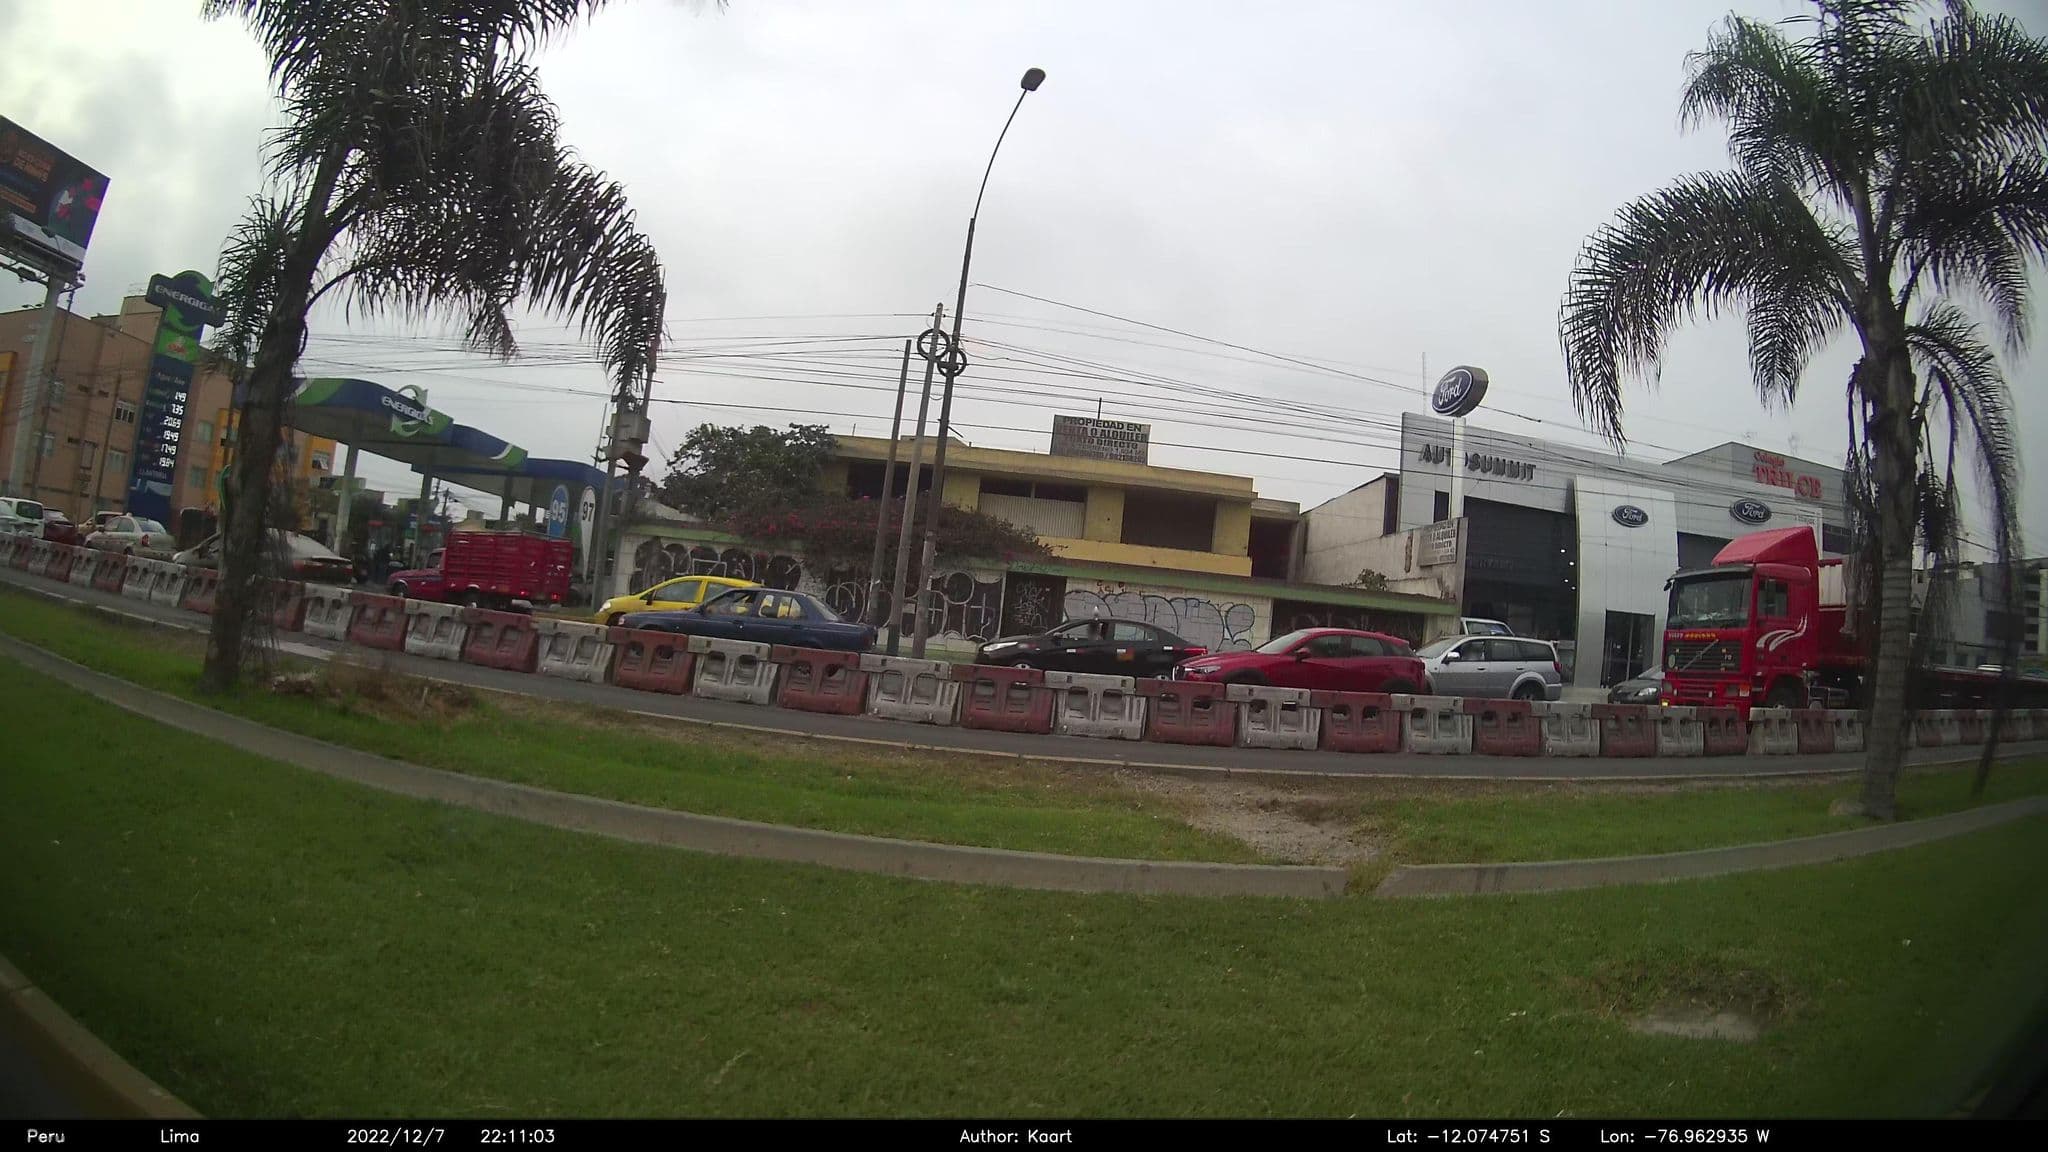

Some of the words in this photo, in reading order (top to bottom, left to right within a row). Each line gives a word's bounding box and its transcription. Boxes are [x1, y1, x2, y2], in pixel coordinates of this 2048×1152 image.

[1438, 375, 1463, 406] Ford
[1063, 417, 1124, 430] PROPIEDAD
[1126, 423, 1142, 432] EN
[1418, 443, 1537, 482] AUTSUMMIT
[552, 499, 568, 524] 95
[582, 501, 595, 522] 97
[1622, 507, 1643, 522] Ford
[1742, 502, 1765, 519] Ford
